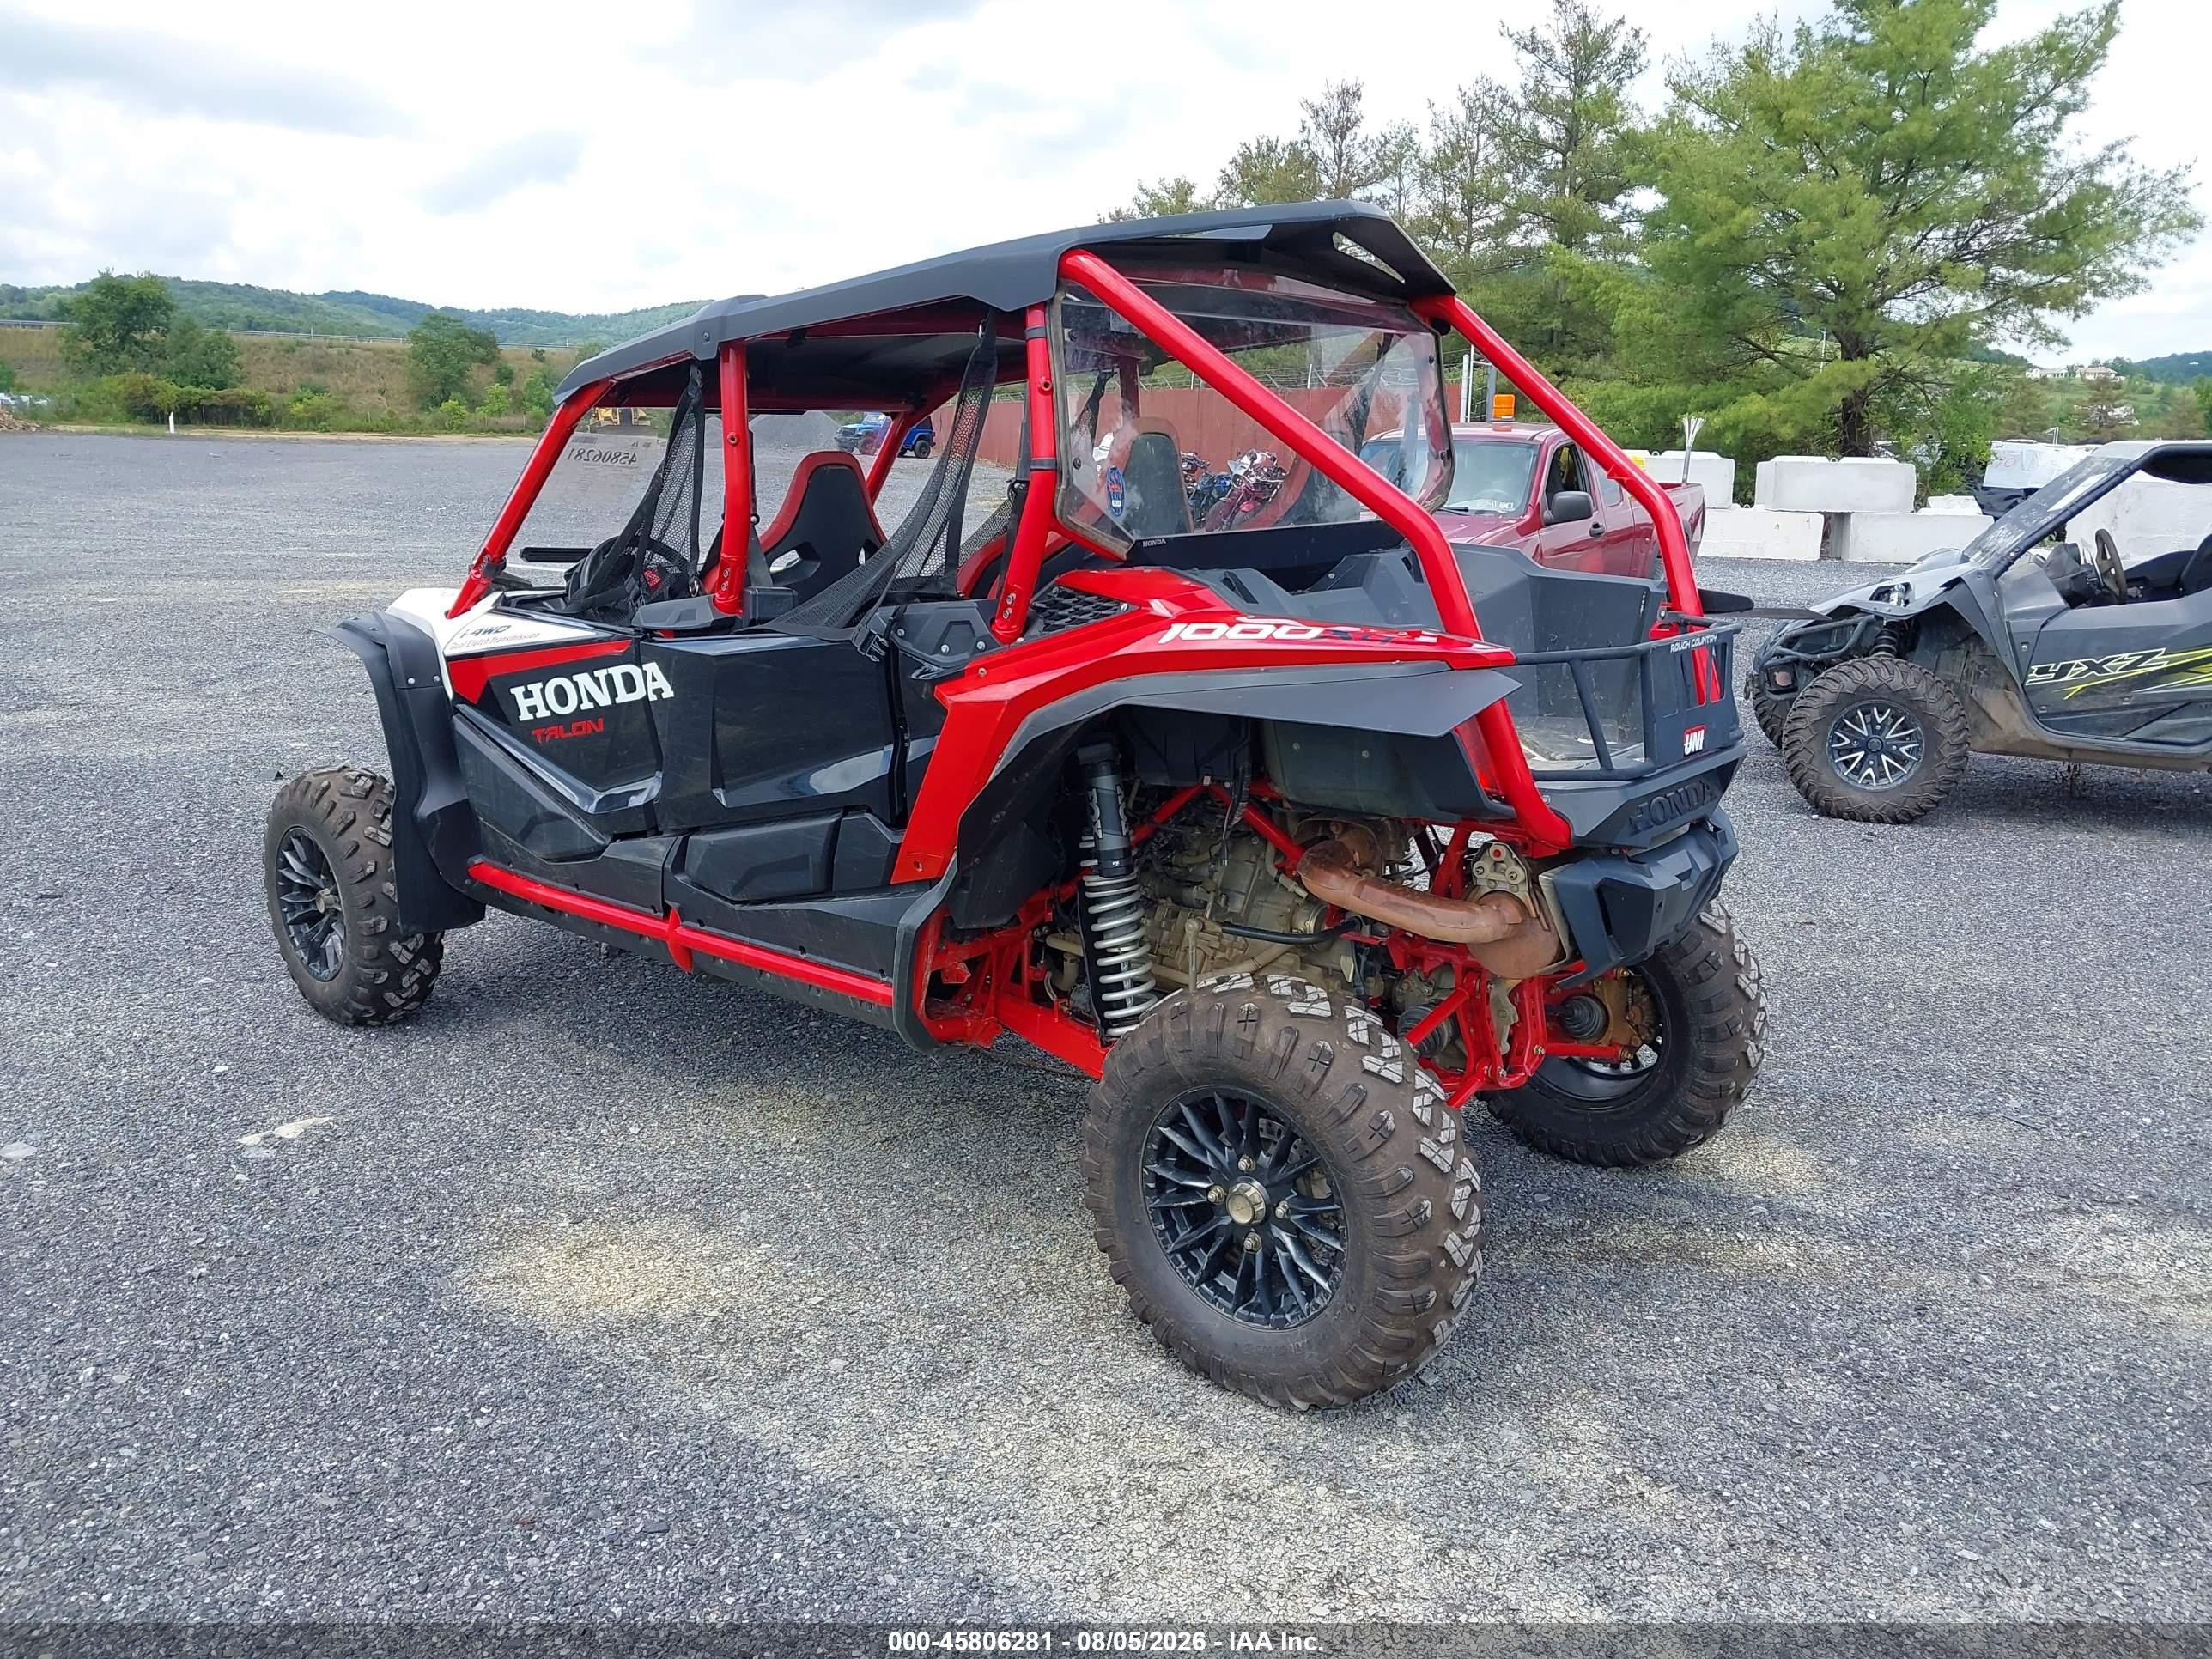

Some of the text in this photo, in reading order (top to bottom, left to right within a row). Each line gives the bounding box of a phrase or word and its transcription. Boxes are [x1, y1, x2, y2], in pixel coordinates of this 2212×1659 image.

[1142, 538, 1167, 548] HONDA
[1158, 623, 1324, 644] 1000
[1670, 633, 1718, 653] ROUGH COUNTRY
[2025, 647, 2169, 686] YXZ
[509, 662, 675, 721] HONDA
[531, 717, 605, 744] TALON
[1683, 728, 1705, 756] UNI
[1629, 779, 1718, 834] HONDA
